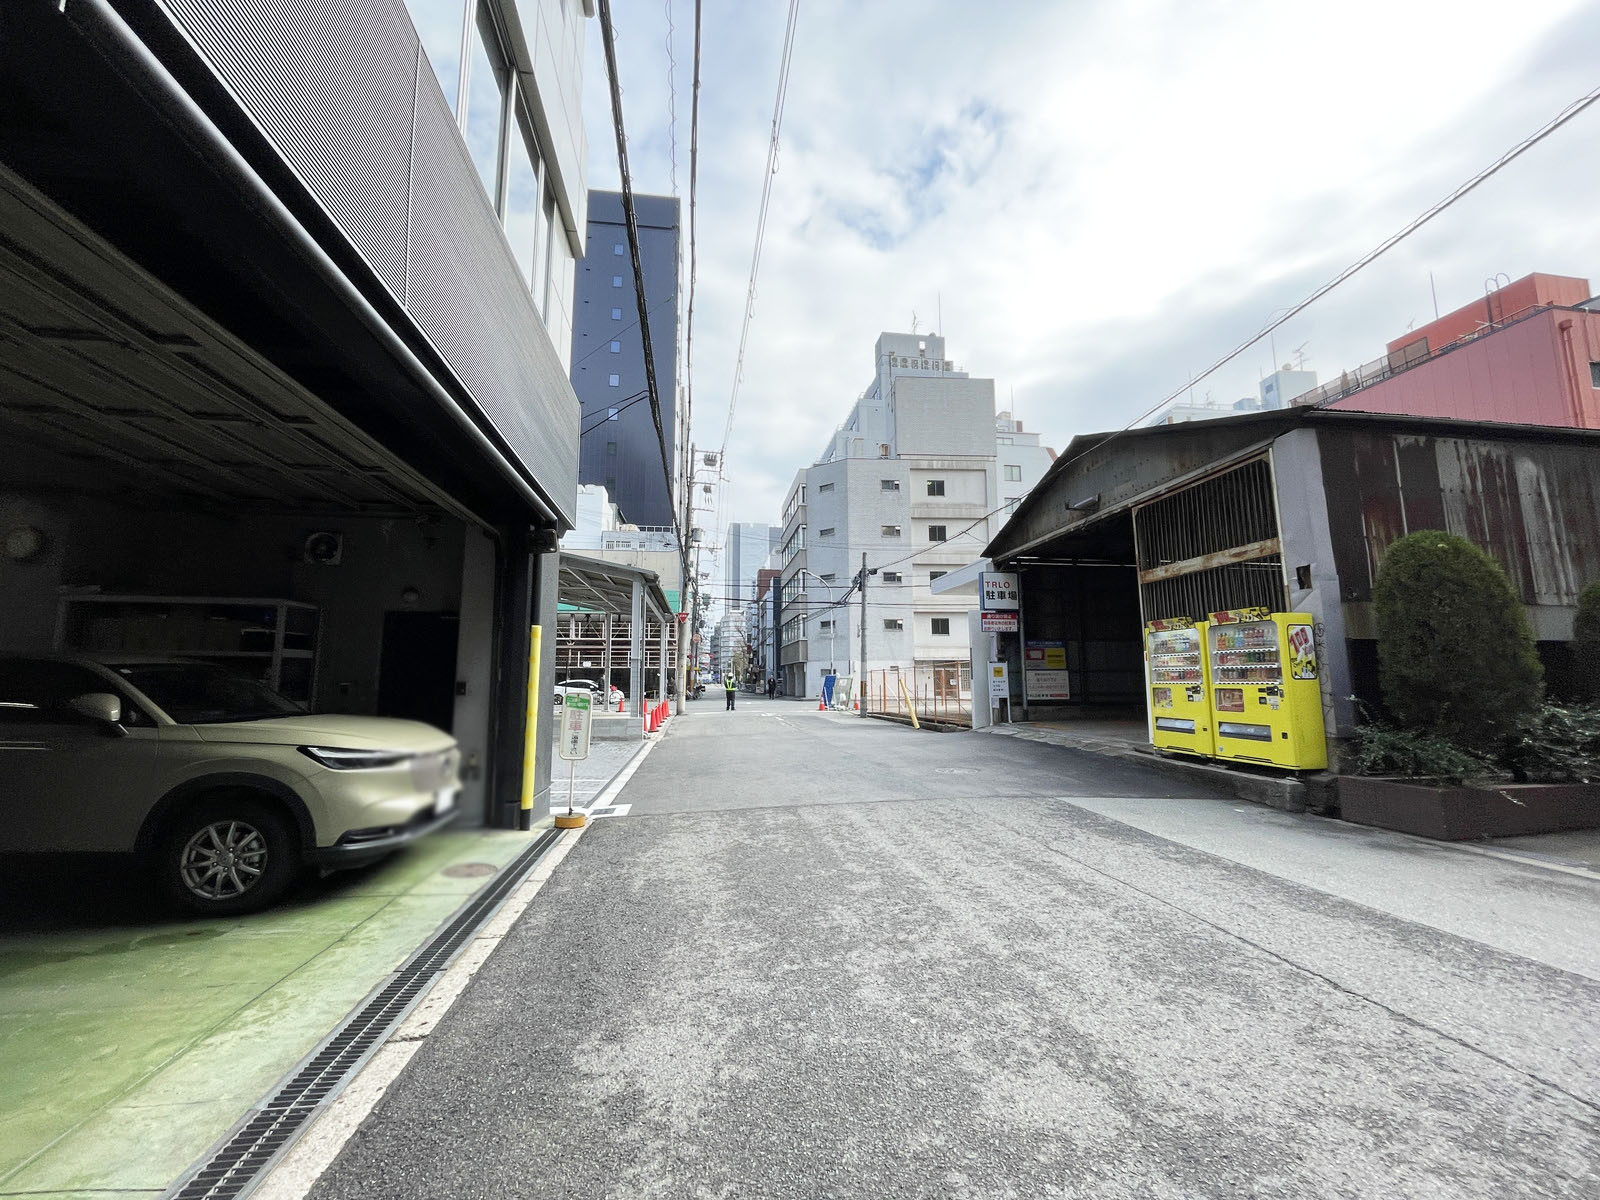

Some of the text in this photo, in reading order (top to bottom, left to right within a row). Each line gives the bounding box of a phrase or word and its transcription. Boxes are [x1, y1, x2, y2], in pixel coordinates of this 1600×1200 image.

[985, 581, 1010, 589] TRLO
[986, 590, 1017, 600] 駐車場
[1289, 627, 1310, 656] 100
